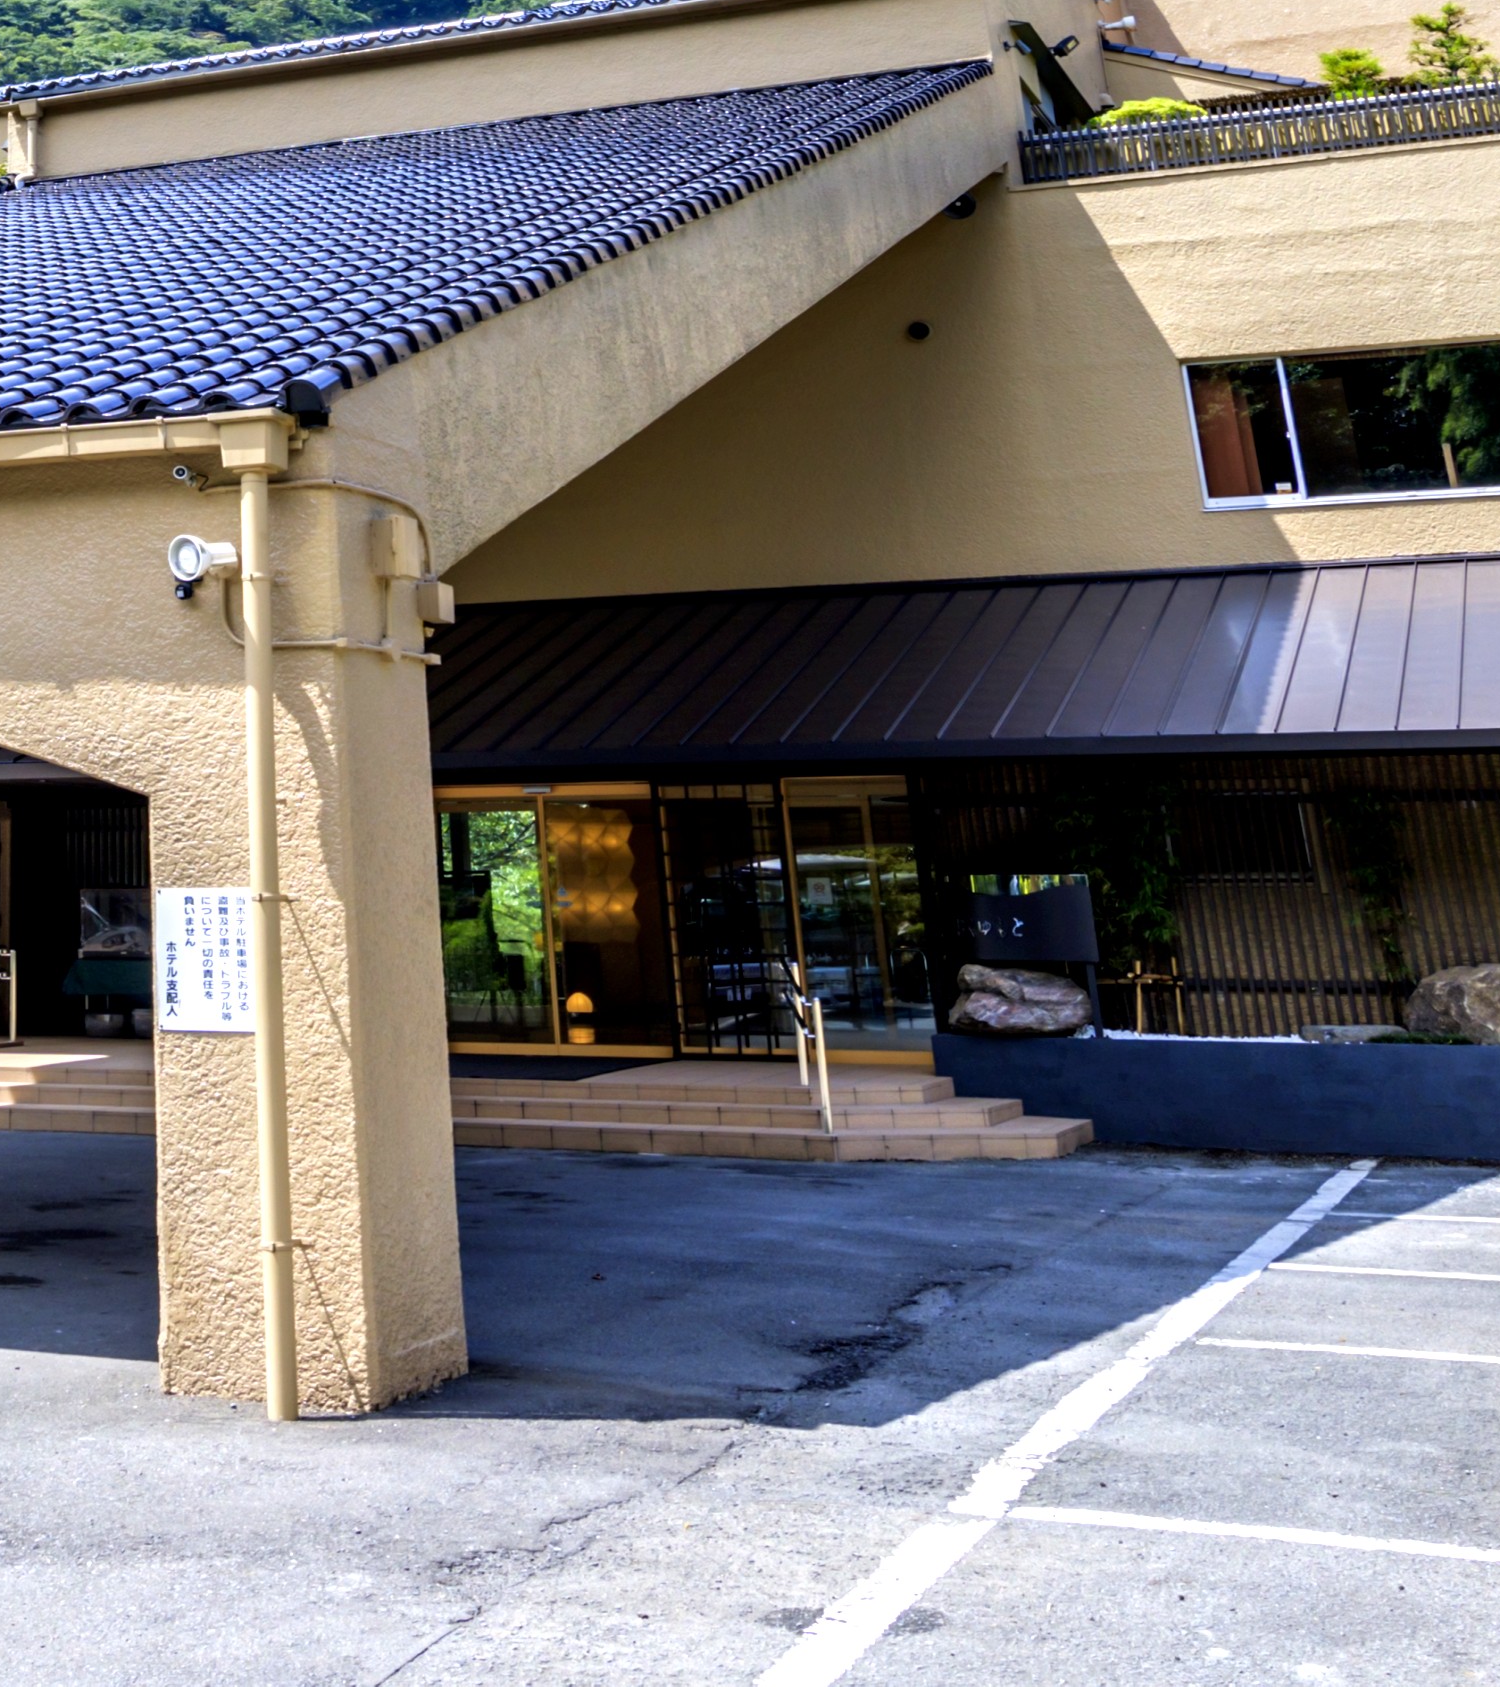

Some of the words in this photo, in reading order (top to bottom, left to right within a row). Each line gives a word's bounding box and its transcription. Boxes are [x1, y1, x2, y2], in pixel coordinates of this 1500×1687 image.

[184, 895, 196, 947] 負いません
[201, 896, 214, 1000] について一切の責任を
[166, 940, 178, 1017] ホテル支配人
